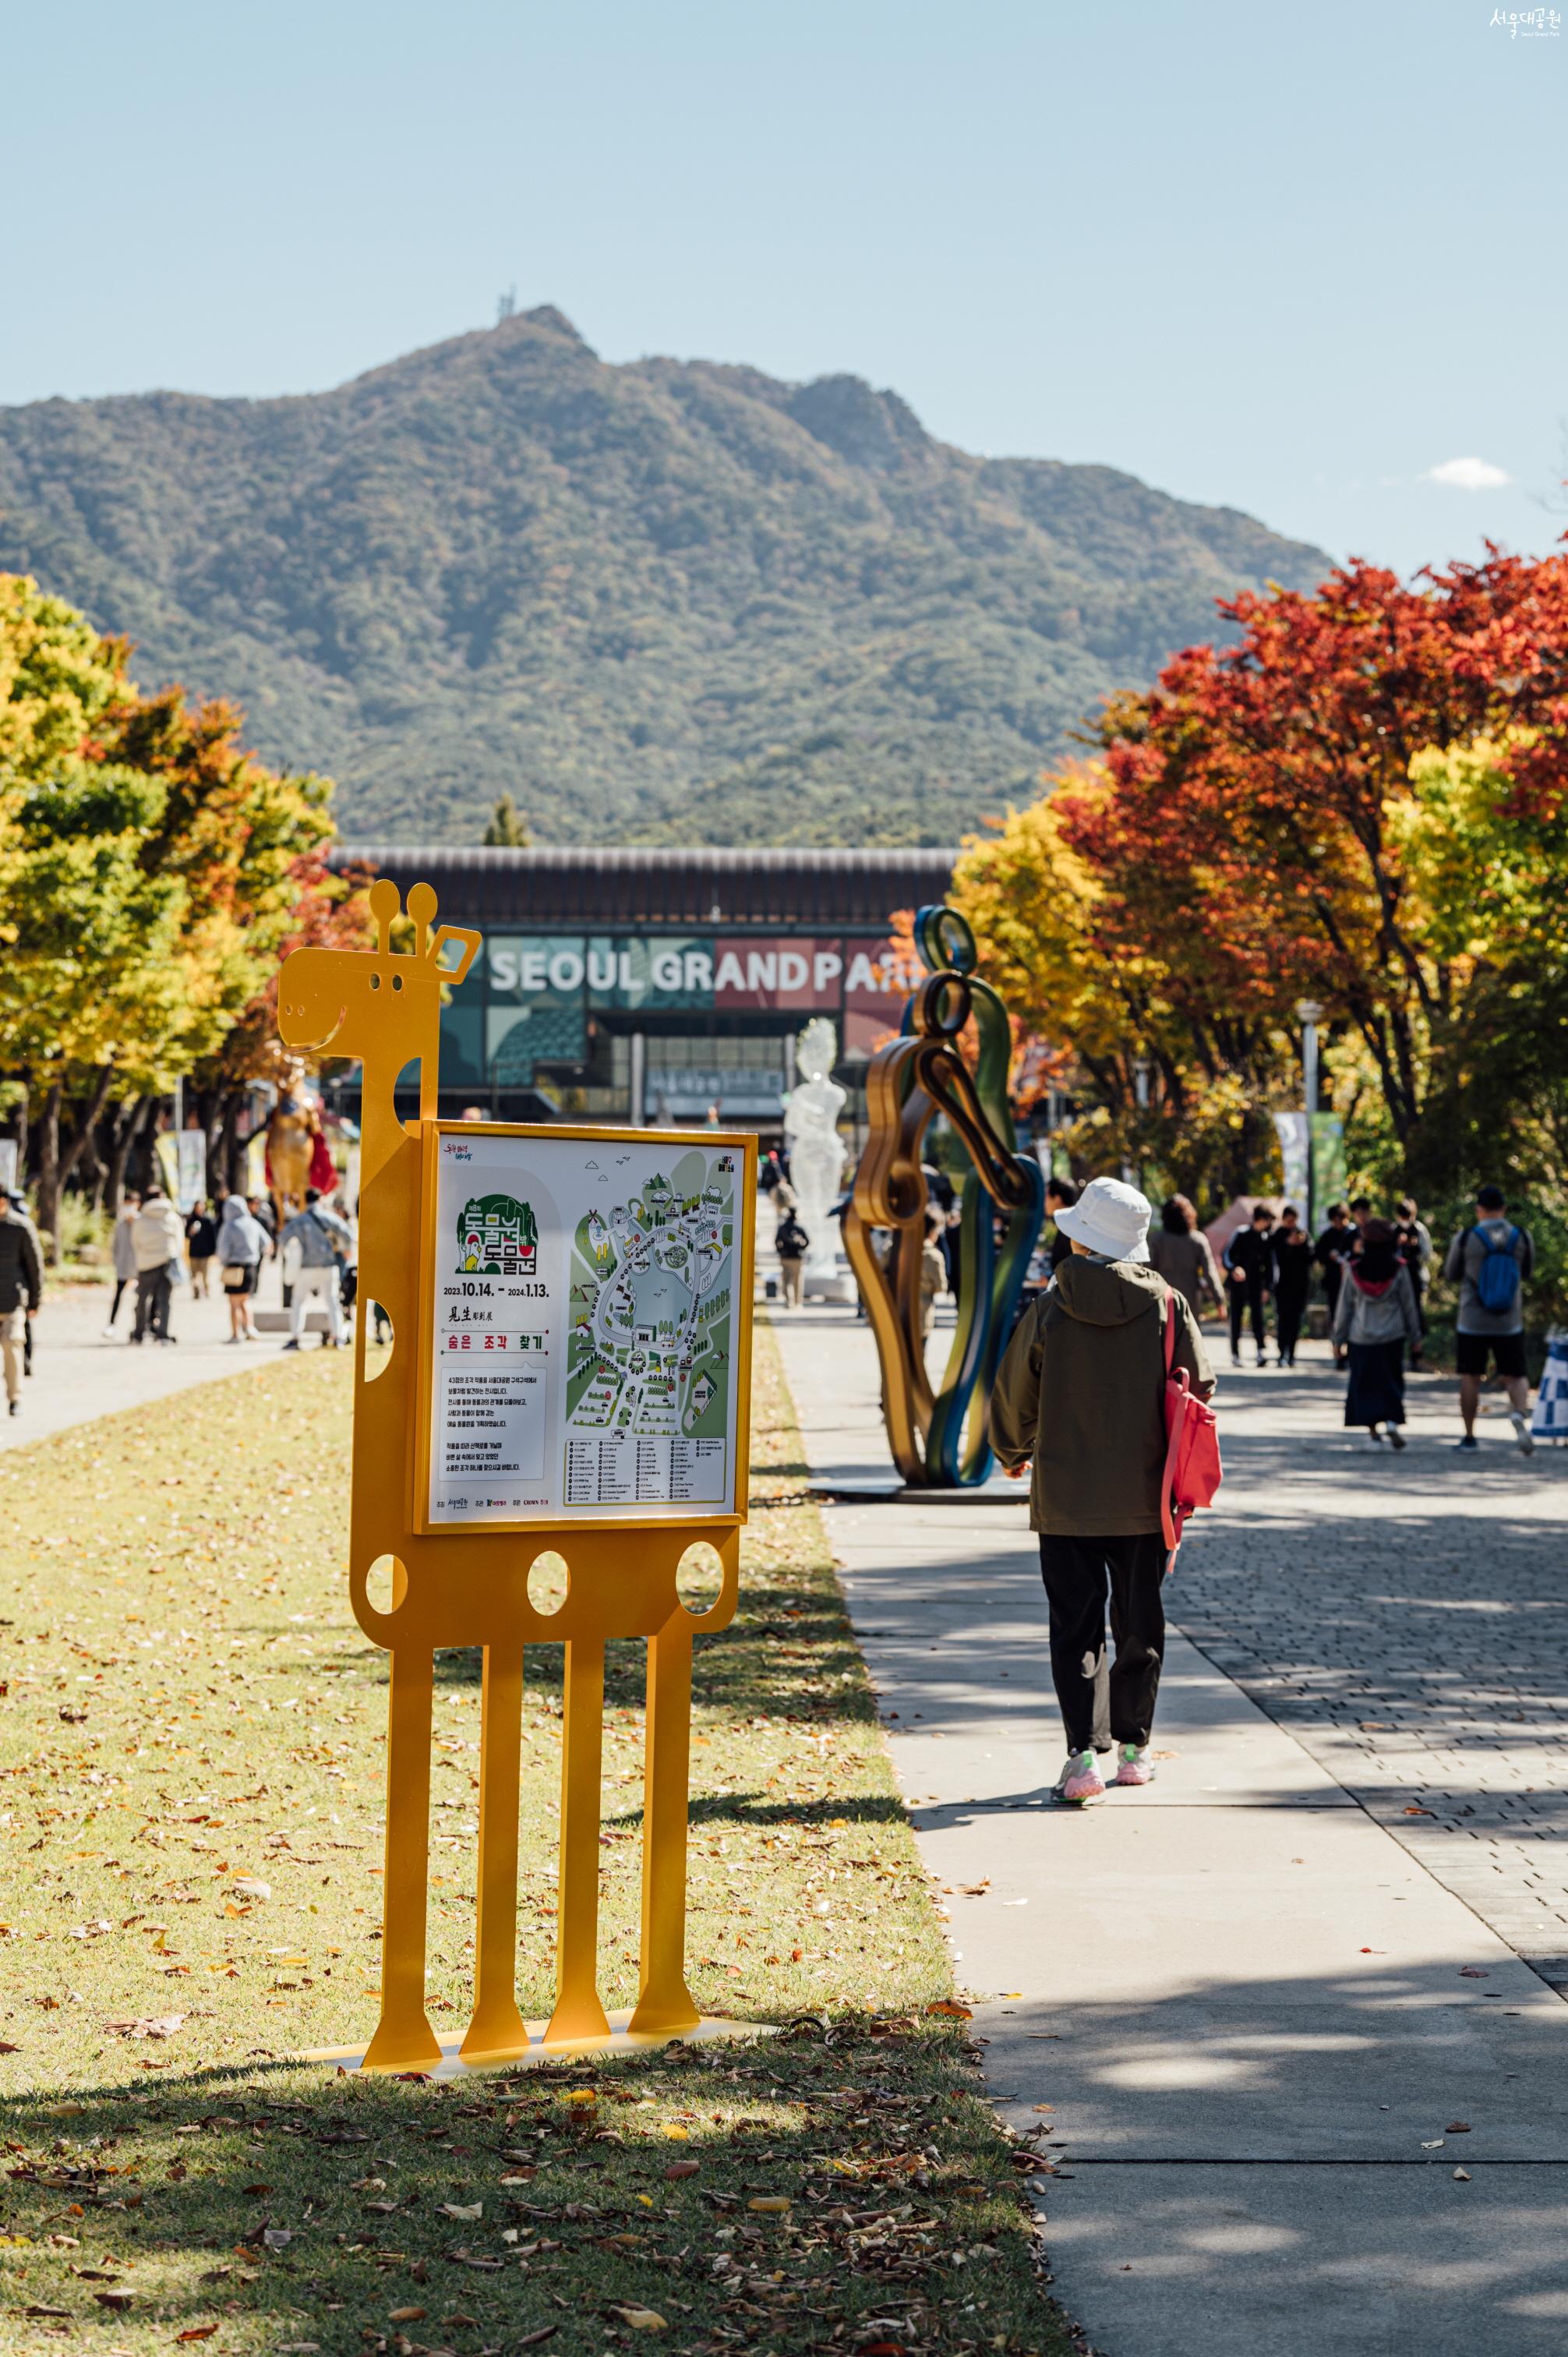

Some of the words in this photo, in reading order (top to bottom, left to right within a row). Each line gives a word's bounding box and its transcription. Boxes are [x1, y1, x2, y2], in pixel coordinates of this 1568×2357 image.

[490, 951, 645, 991] SEOUL
[651, 951, 809, 991] GRAND
[465, 1213, 520, 1247] 동물원
[443, 1282, 494, 1296] 2023.10.14.
[507, 1284, 549, 1297] 2024.1.13.
[448, 1335, 471, 1349] 숨은
[484, 1335, 507, 1349] 조각
[520, 1335, 542, 1349] 찾기
